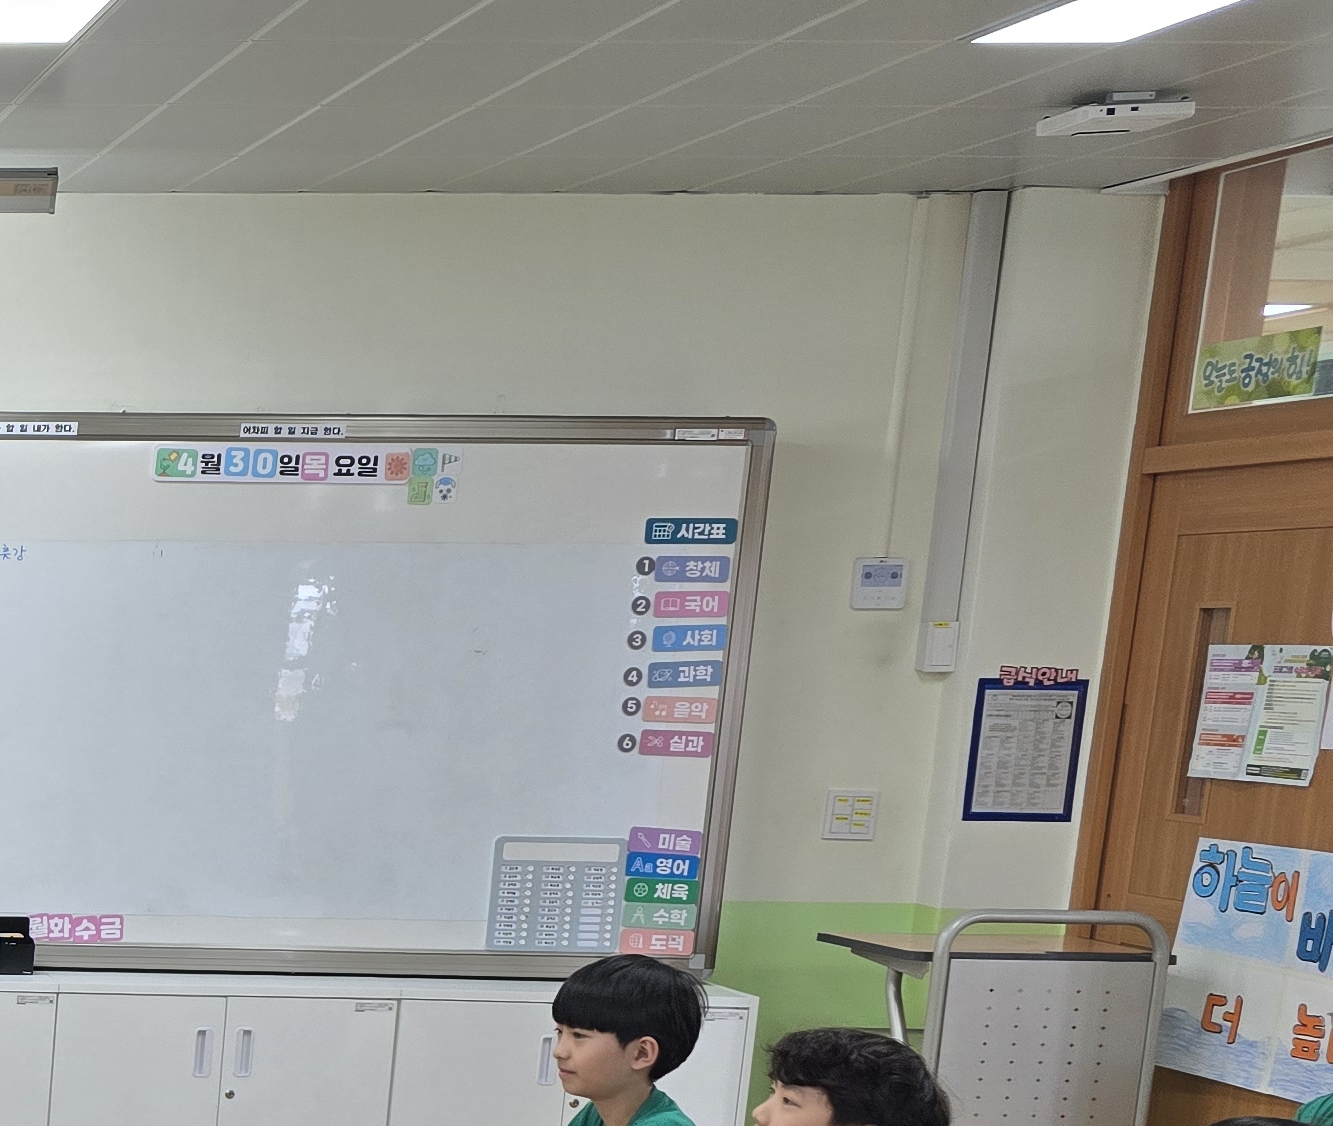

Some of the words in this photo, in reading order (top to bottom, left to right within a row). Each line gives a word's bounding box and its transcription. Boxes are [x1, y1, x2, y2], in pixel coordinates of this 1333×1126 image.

[1203, 359, 1237, 393] 오늘도
[1241, 353, 1282, 389] 긍정의
[1286, 347, 1313, 381] 힘!
[20, 423, 28, 433] 일
[33, 423, 50, 433] 내가
[55, 423, 75, 433] 한다.
[243, 425, 269, 435] 어차피
[287, 426, 296, 436] 일
[301, 426, 319, 436] 지금
[323, 426, 344, 436] 한다.
[677, 523, 727, 540] 시간표
[641, 560, 650, 572] 1
[685, 561, 720, 578] 창체
[636, 600, 646, 611] 2
[684, 596, 719, 613] 국어
[632, 635, 642, 646] 3
[683, 629, 717, 646] 사회
[627, 670, 638, 682] 4
[677, 665, 713, 682] 과학
[1000, 665, 1079, 686] 급식안내
[626, 700, 637, 712] 5
[673, 702, 709, 719] 음악
[621, 737, 632, 748] 6
[669, 735, 704, 752] 실과
[658, 833, 692, 852] 미술
[655, 858, 689, 876] 영어
[1192, 843, 1300, 922] 하늘이
[654, 883, 689, 901] 체육
[652, 907, 688, 925] 수학
[650, 934, 685, 951] 도덕
[1201, 992, 1244, 1045] 더
[1290, 1003, 1333, 1064] 높
